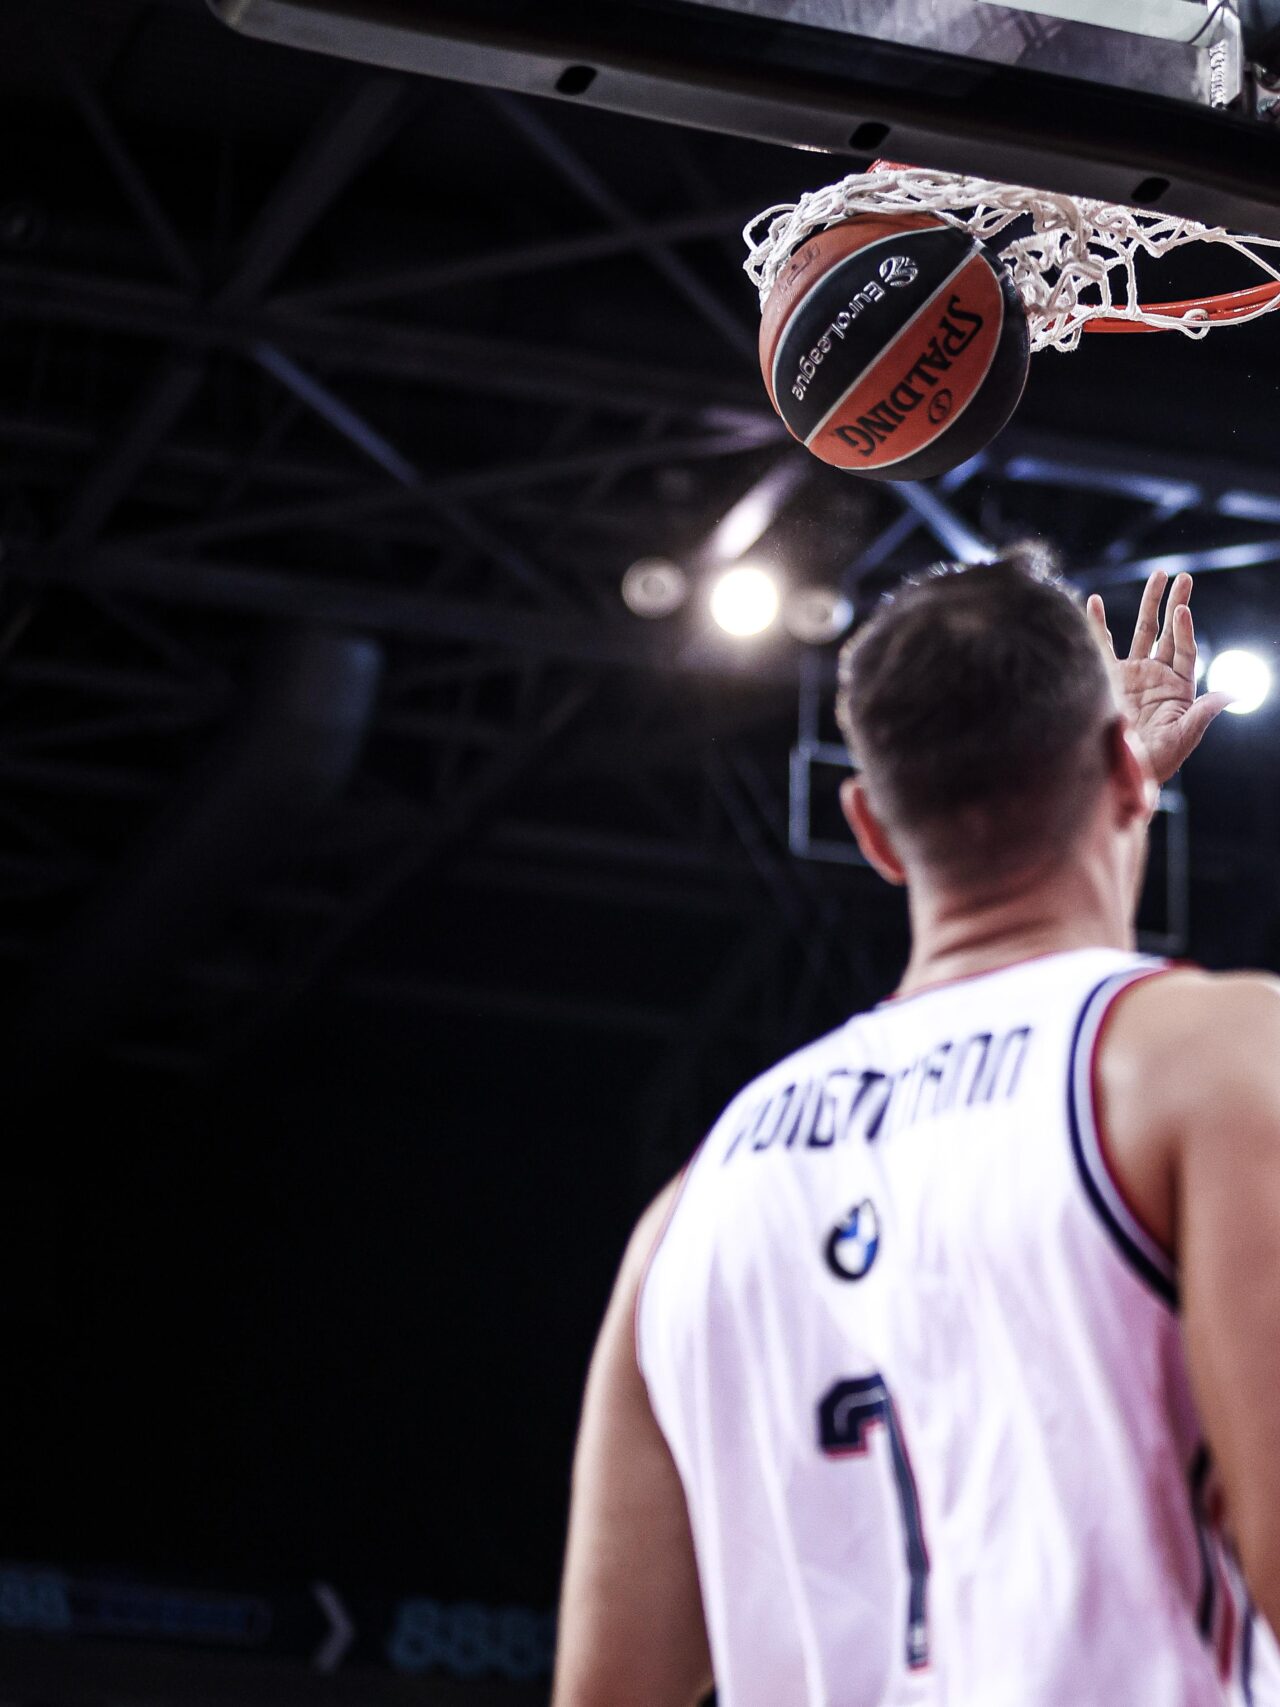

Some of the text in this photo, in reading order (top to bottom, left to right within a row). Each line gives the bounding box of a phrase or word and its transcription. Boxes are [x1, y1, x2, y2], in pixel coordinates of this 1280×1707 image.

[791, 280, 886, 401] EuroLeague
[834, 294, 984, 456] SPALDING
[817, 1372, 930, 1674] 7
